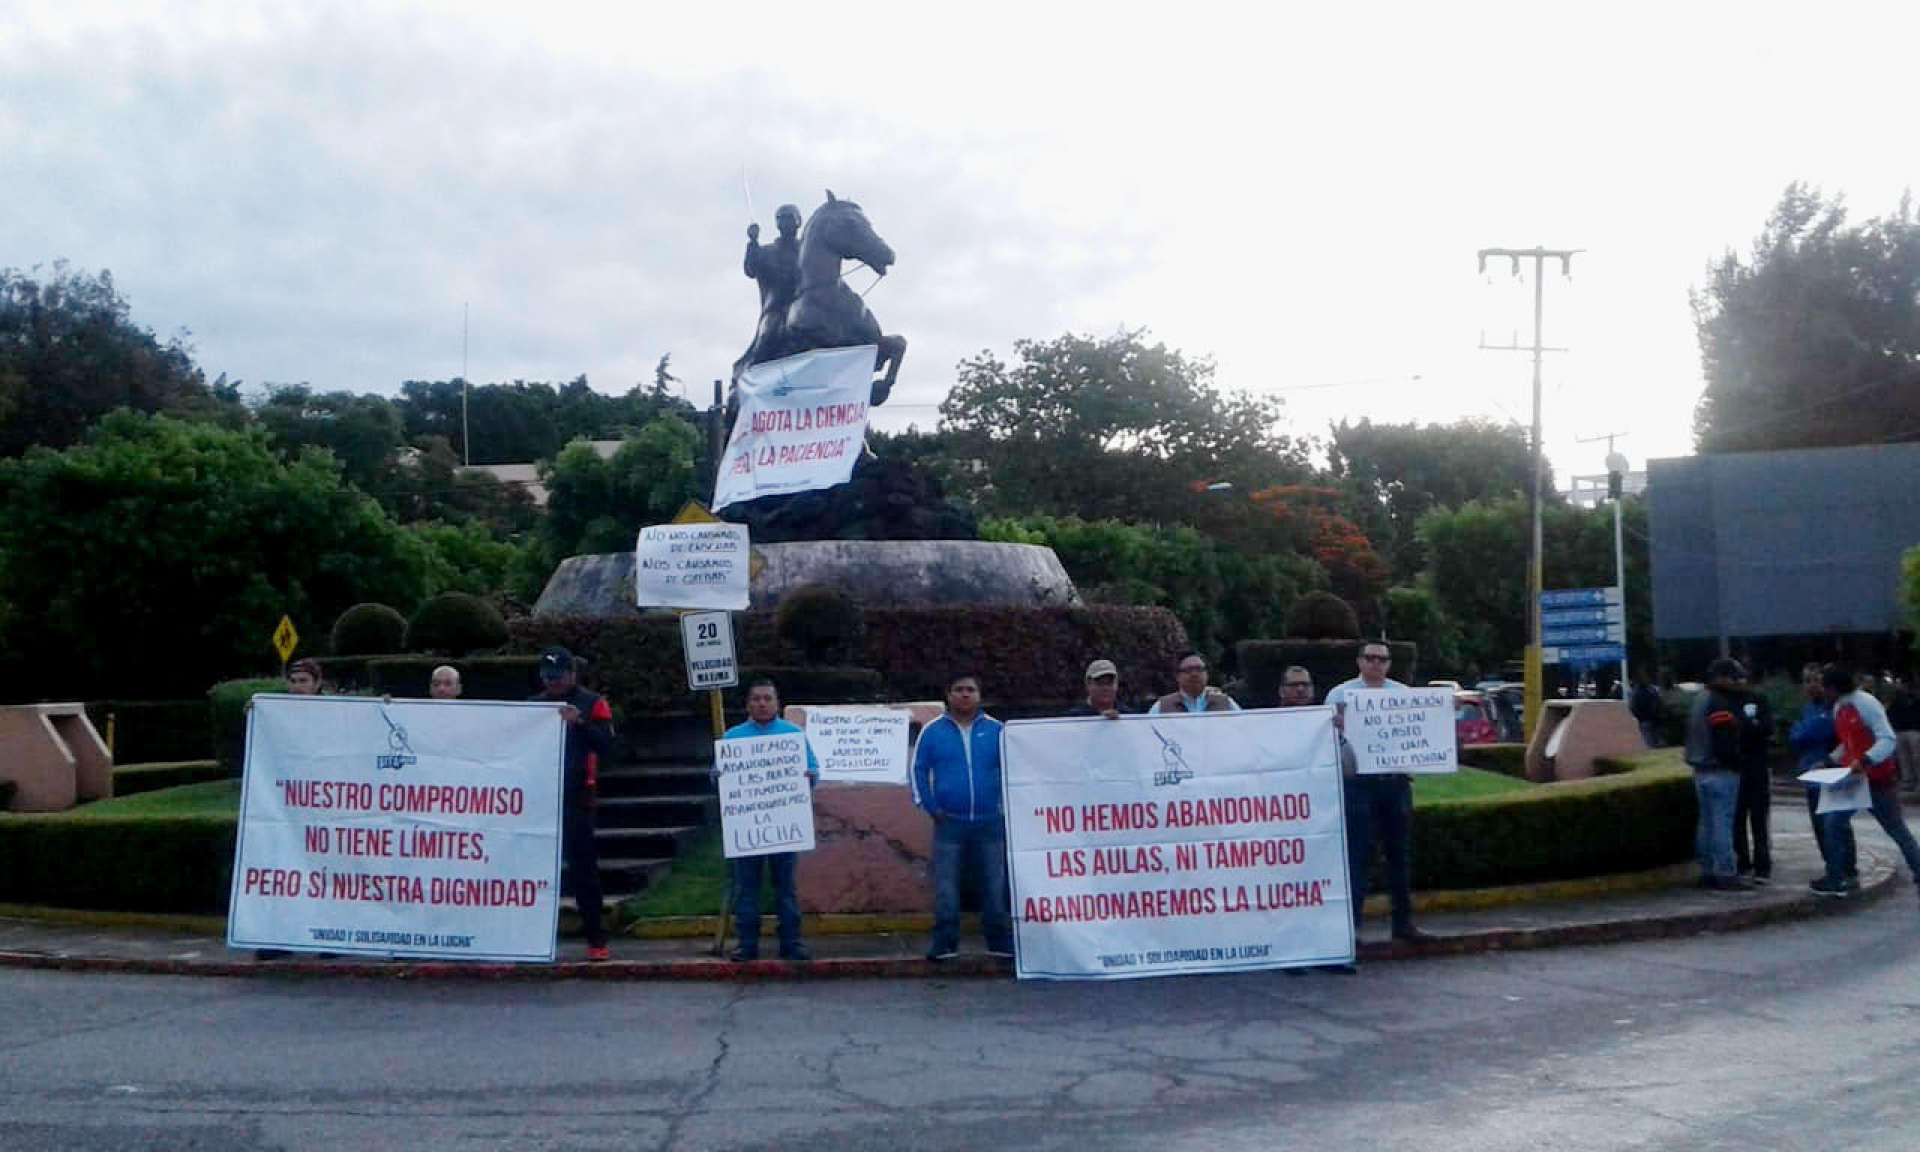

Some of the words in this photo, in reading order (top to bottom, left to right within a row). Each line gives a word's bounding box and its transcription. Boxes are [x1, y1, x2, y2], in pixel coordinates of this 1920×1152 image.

[796, 408, 812, 430] LA
[757, 445, 774, 466] LA
[698, 623, 717, 639] 20
[1408, 711, 1425, 722] UN
[720, 744, 742, 759] NO
[276, 779, 372, 809] “NUESTRO
[379, 784, 523, 815] COMPROMISO
[754, 813, 771, 824] LA
[1035, 806, 1075, 834] “NO
[1082, 802, 1158, 831] HEMOS
[1166, 793, 1311, 828] ABANDONADO
[305, 825, 329, 853] NO
[336, 827, 393, 856] TIENE
[400, 826, 489, 863] LÍMITES,
[1047, 850, 1086, 878] LAS
[1093, 845, 1170, 875] AULAS,
[1176, 844, 1197, 870] NI
[1203, 838, 1305, 868] TAMPOCO
[245, 868, 301, 896] PERO
[308, 867, 327, 898] SÍ
[333, 873, 423, 903] NUESTRA
[431, 878, 548, 907] DIGNIDAD”
[1025, 888, 1216, 923] ABANDONAREMOS
[1222, 886, 1249, 912] LA
[1256, 879, 1331, 910] LUCHA”
[414, 934, 426, 945] EN
[429, 935, 439, 946] LA
[1211, 948, 1222, 960] EN
[1225, 948, 1237, 959] LA
